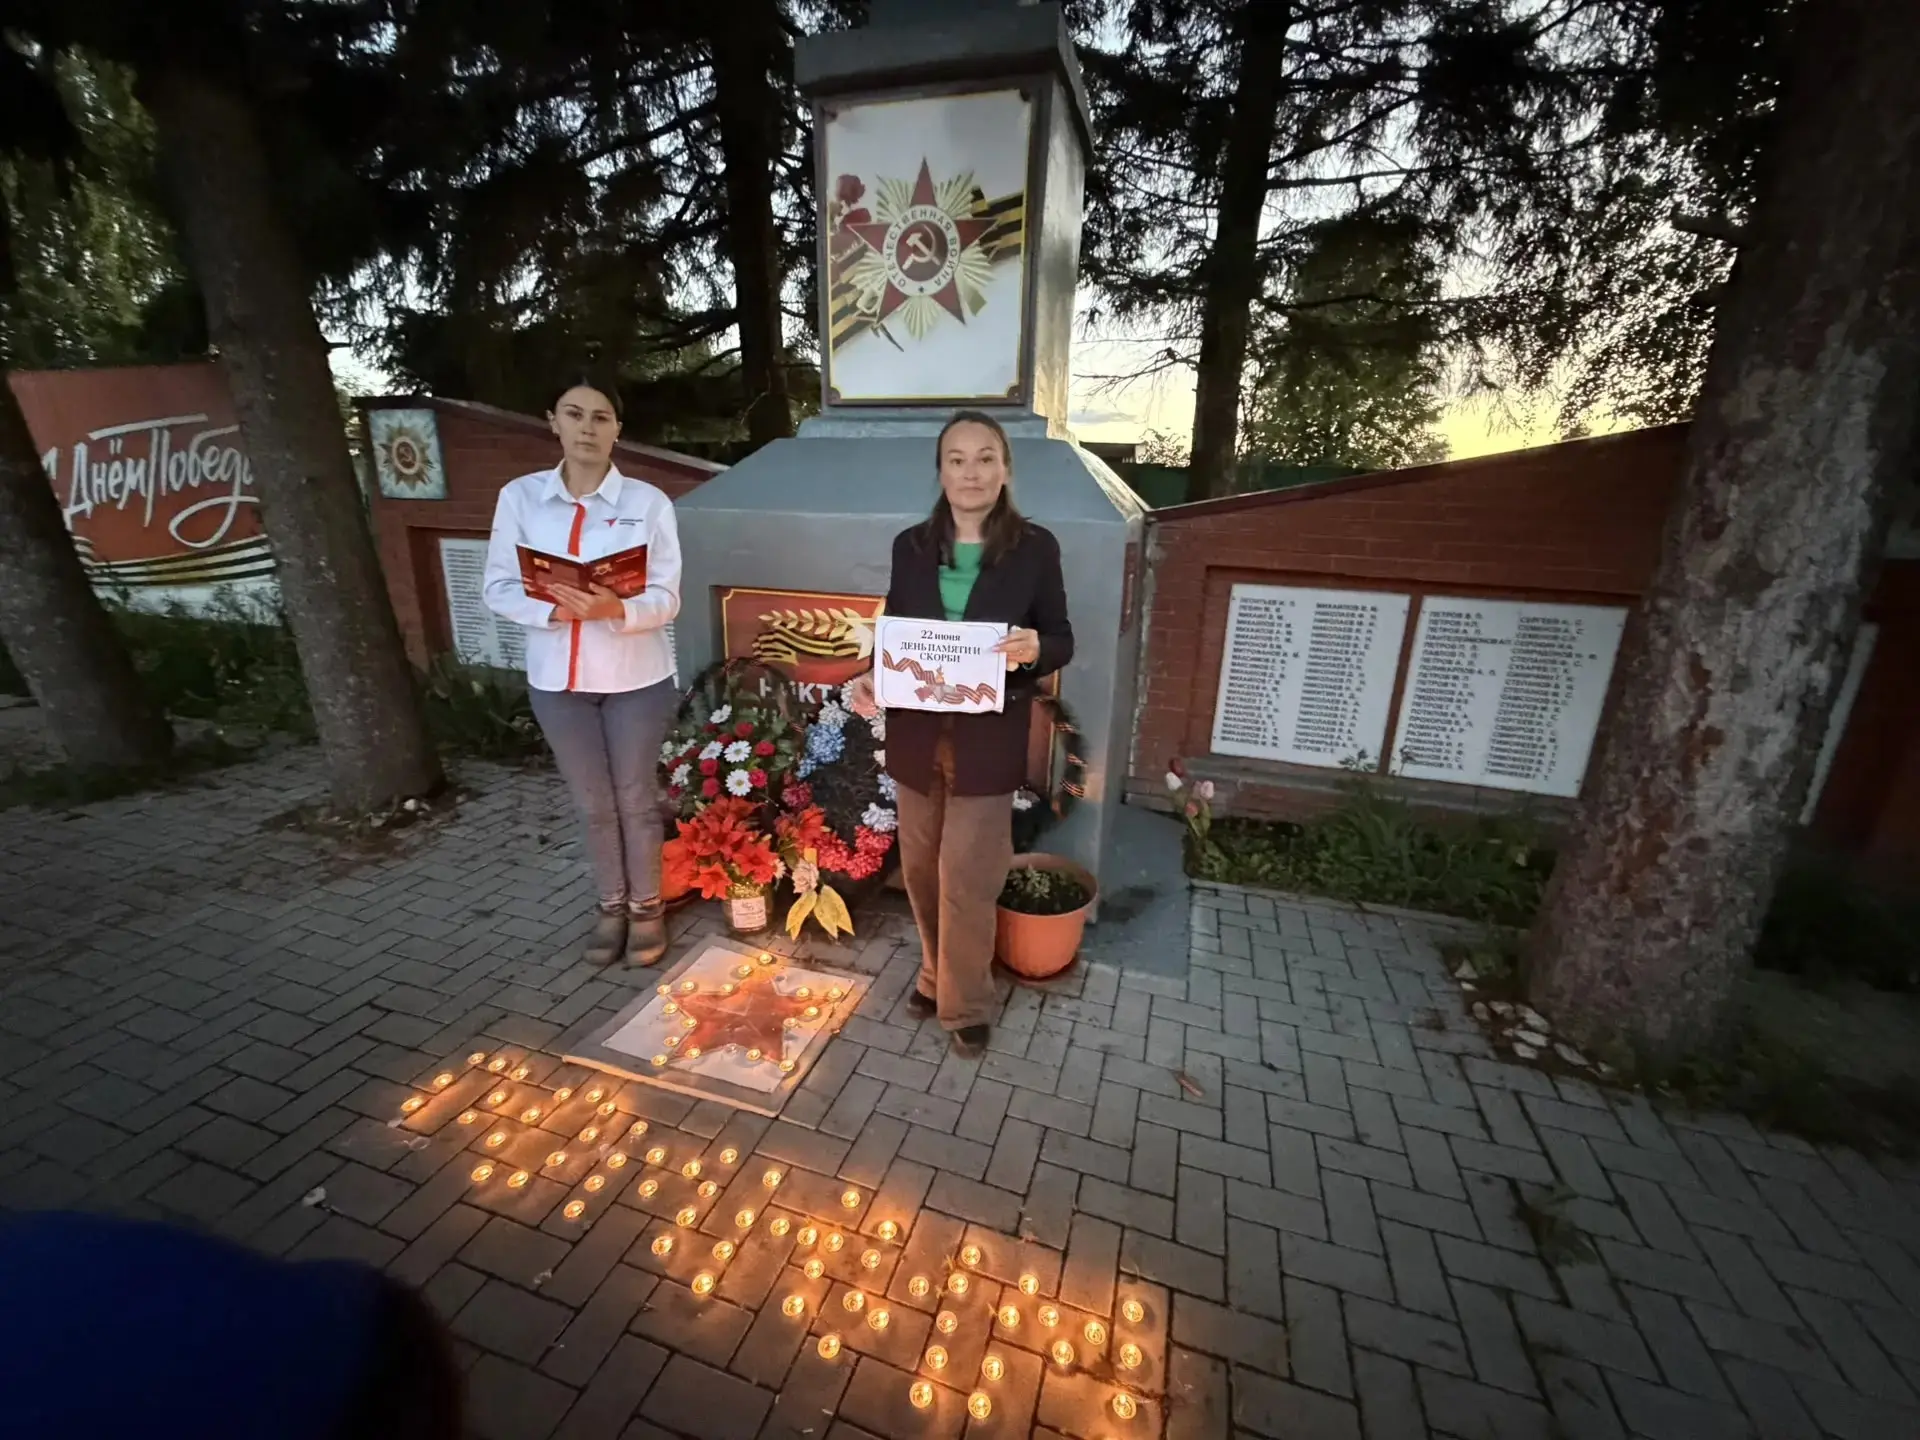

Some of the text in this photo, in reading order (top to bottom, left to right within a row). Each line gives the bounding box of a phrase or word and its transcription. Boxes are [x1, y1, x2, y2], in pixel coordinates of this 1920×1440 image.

[881, 209, 952, 287] ОТЕЧЕСТВЕННАЯ
[64, 440, 146, 531] Днём
[921, 630, 961, 641] 22 июня
[900, 641, 980, 655] ДЕНЬ ПАМЯТИ И
[920, 652, 960, 662] СКОРБИ
